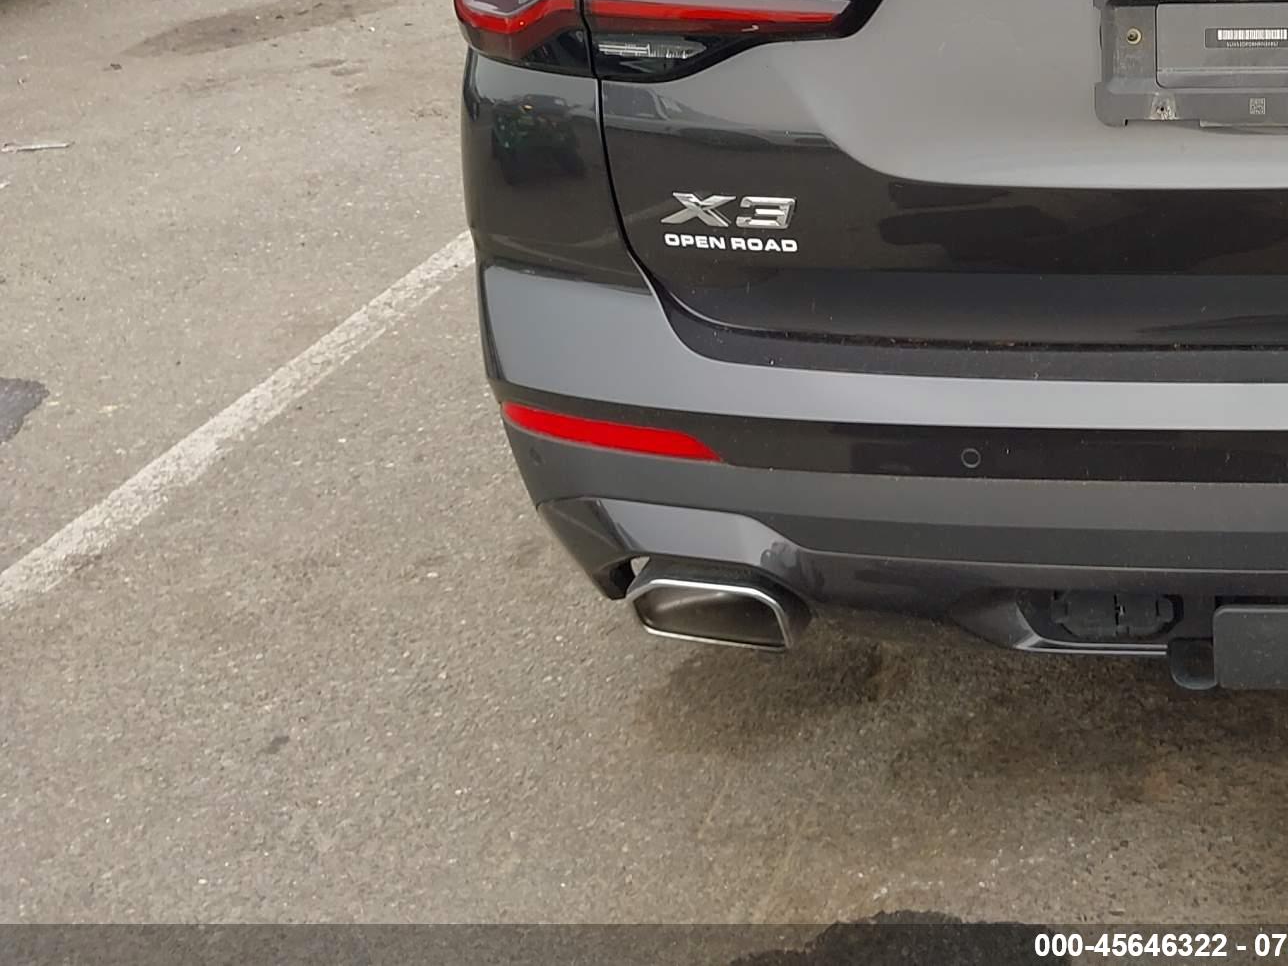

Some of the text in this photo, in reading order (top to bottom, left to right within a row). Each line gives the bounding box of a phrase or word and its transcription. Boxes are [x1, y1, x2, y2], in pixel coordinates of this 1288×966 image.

[660, 191, 796, 230] X3
[664, 233, 798, 253] OPEN ROAD
